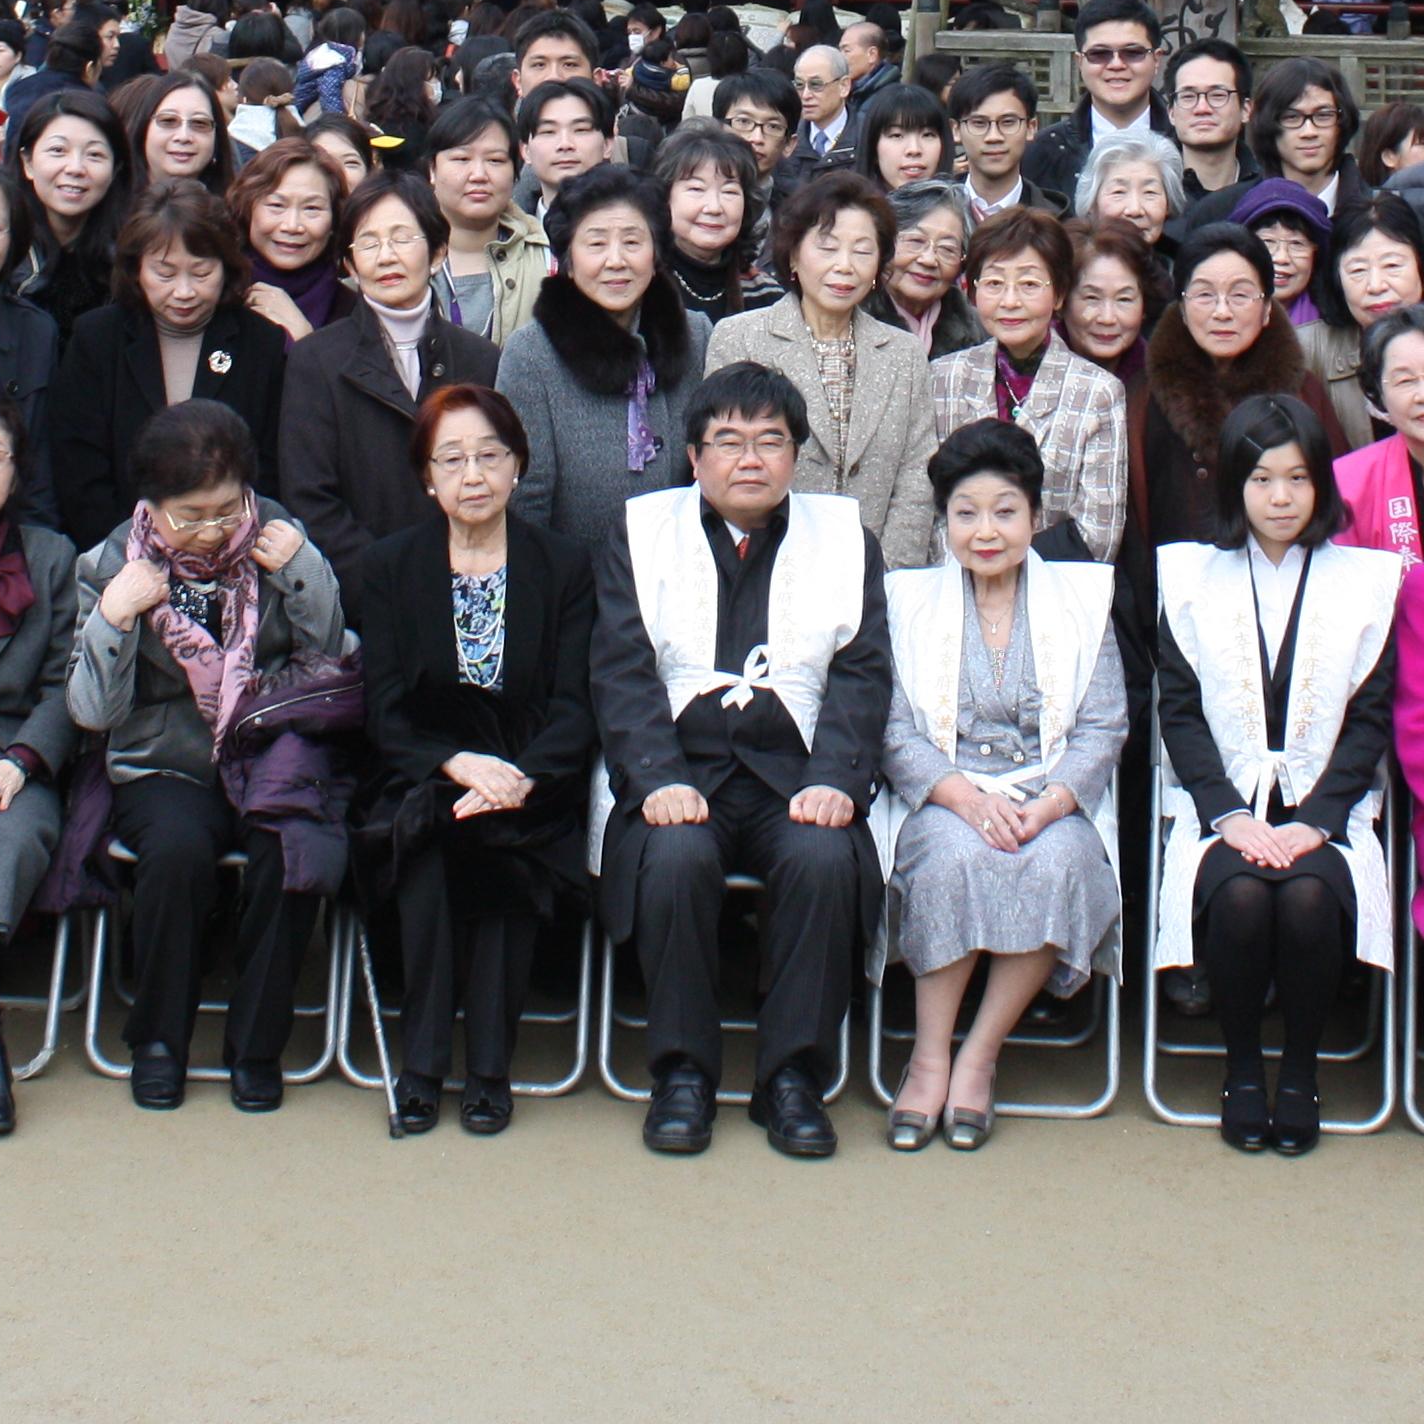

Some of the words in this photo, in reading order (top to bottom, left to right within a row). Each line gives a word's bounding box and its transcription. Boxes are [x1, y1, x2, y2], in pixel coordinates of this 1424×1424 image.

[1231, 610, 1262, 740] 太宰府天満宮
[1294, 610, 1327, 739] 太宰府天満宮
